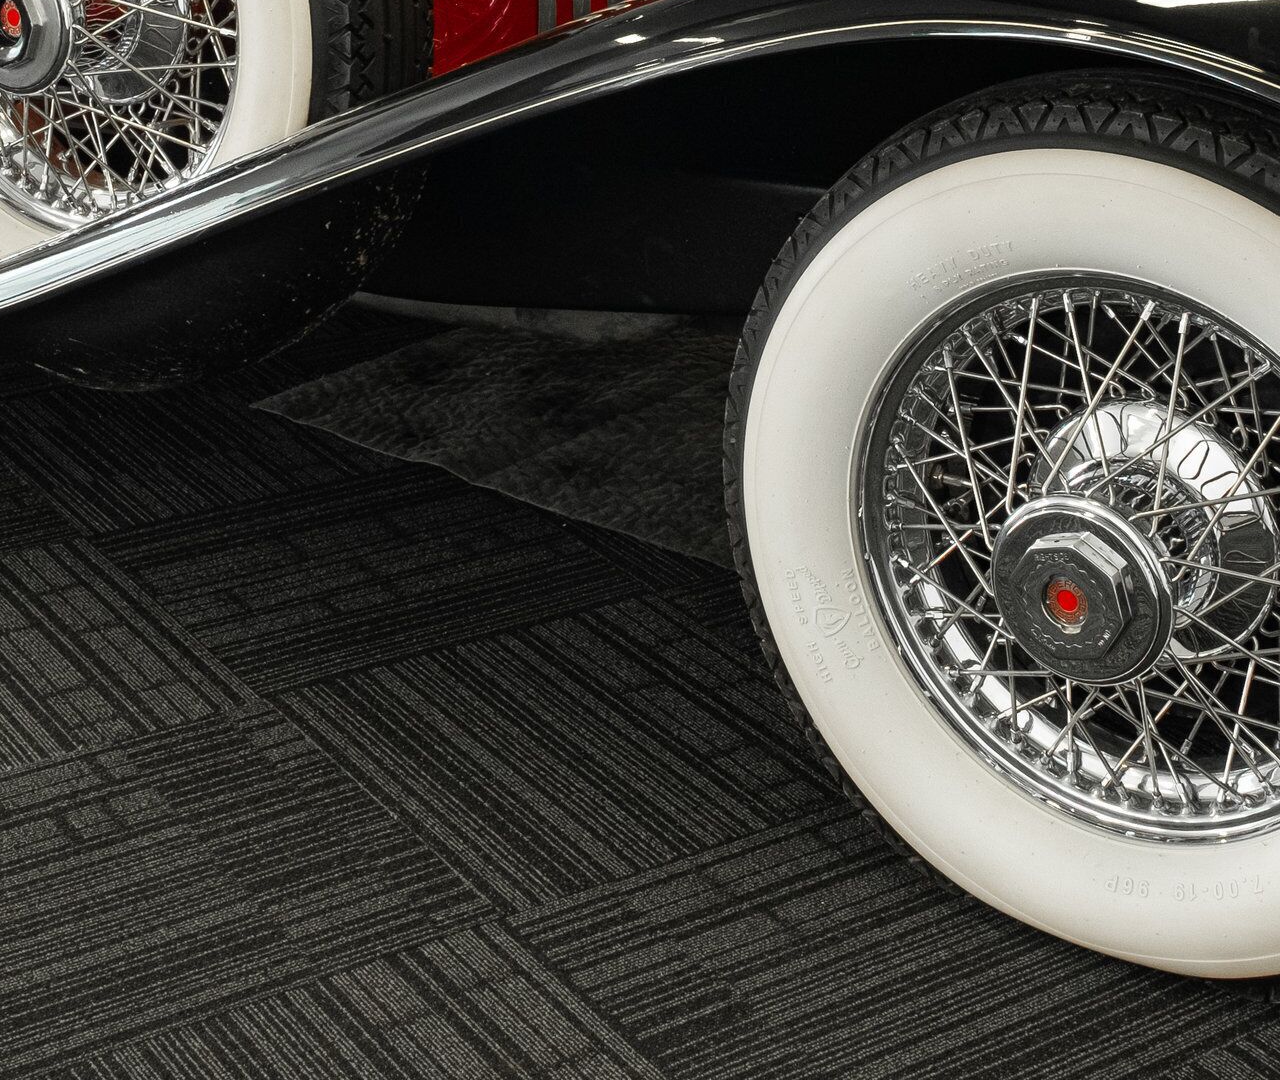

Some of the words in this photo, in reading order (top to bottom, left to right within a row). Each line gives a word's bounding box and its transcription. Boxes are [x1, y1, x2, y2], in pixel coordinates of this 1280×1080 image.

[785, 569, 809, 626] SPEED
[842, 568, 881, 652] BALLOON
[807, 640, 834, 683] HIGH
